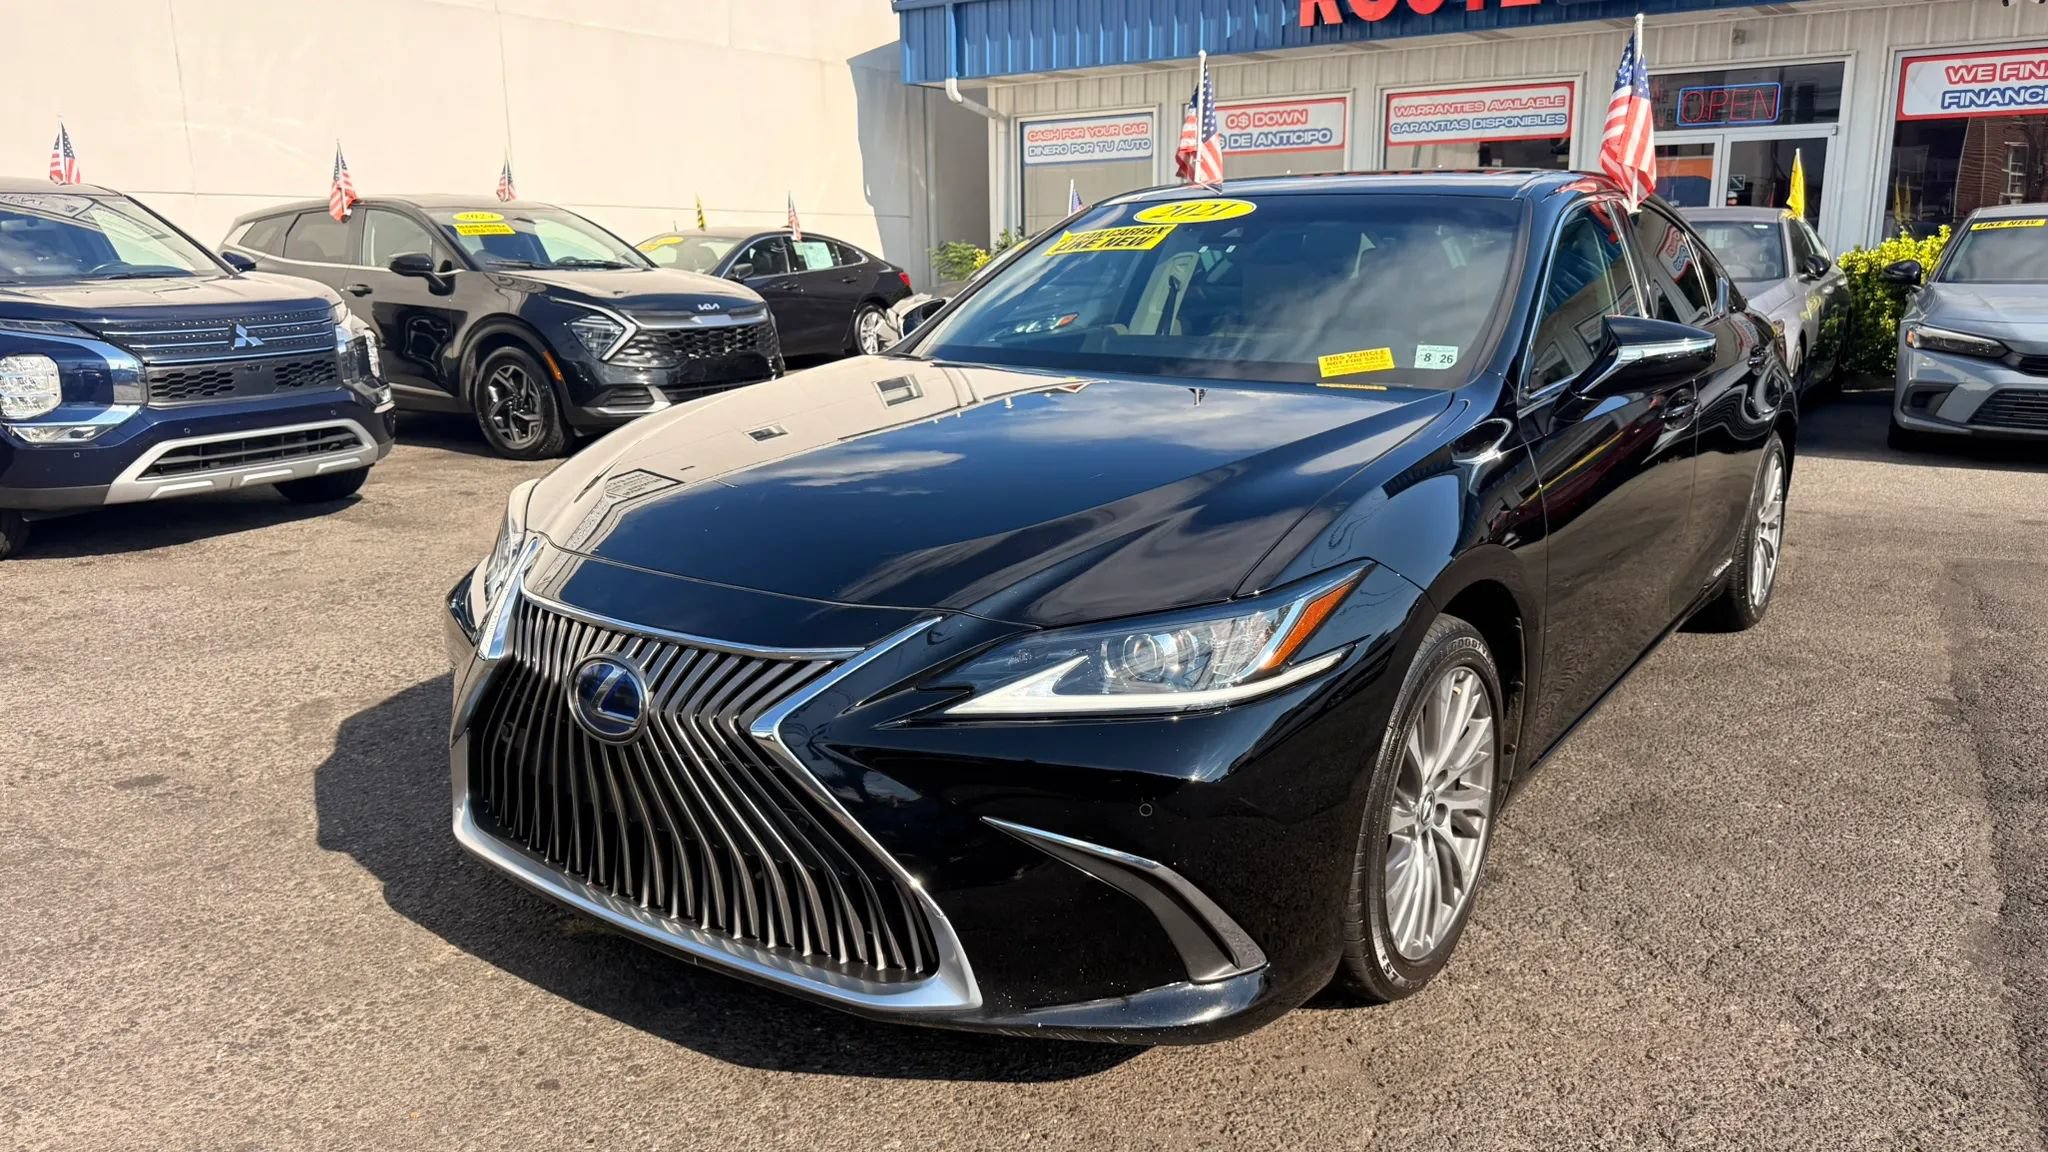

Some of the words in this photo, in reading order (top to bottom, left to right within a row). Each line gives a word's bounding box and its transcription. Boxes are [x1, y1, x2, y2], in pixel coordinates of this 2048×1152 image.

[1945, 63, 1997, 85] WE
[1999, 60, 2048, 81] FIN
[1394, 101, 1485, 118] WARRANTIES
[1487, 95, 1566, 112] AVAILABLE
[1680, 88, 1778, 124] OPEN
[1252, 109, 1308, 128] DOWN
[1390, 119, 1470, 134] GARANTIAS
[1471, 113, 1567, 130] DISPONIBLES
[1028, 130, 1061, 142] CASH
[1062, 128, 1085, 140] FOR
[1088, 126, 1120, 138] YOUR
[1122, 123, 1148, 136] CAR
[1228, 134, 1253, 149] DE
[1254, 128, 1332, 148] ANTICIPO
[1028, 145, 1068, 157] DINERO
[1070, 143, 1095, 155] POR
[1096, 141, 1115, 152] TU
[1116, 138, 1152, 151] AUTO
[1098, 235, 1157, 249] NEW
[1423, 352, 1432, 362] 8
[1440, 353, 1454, 364] 26
